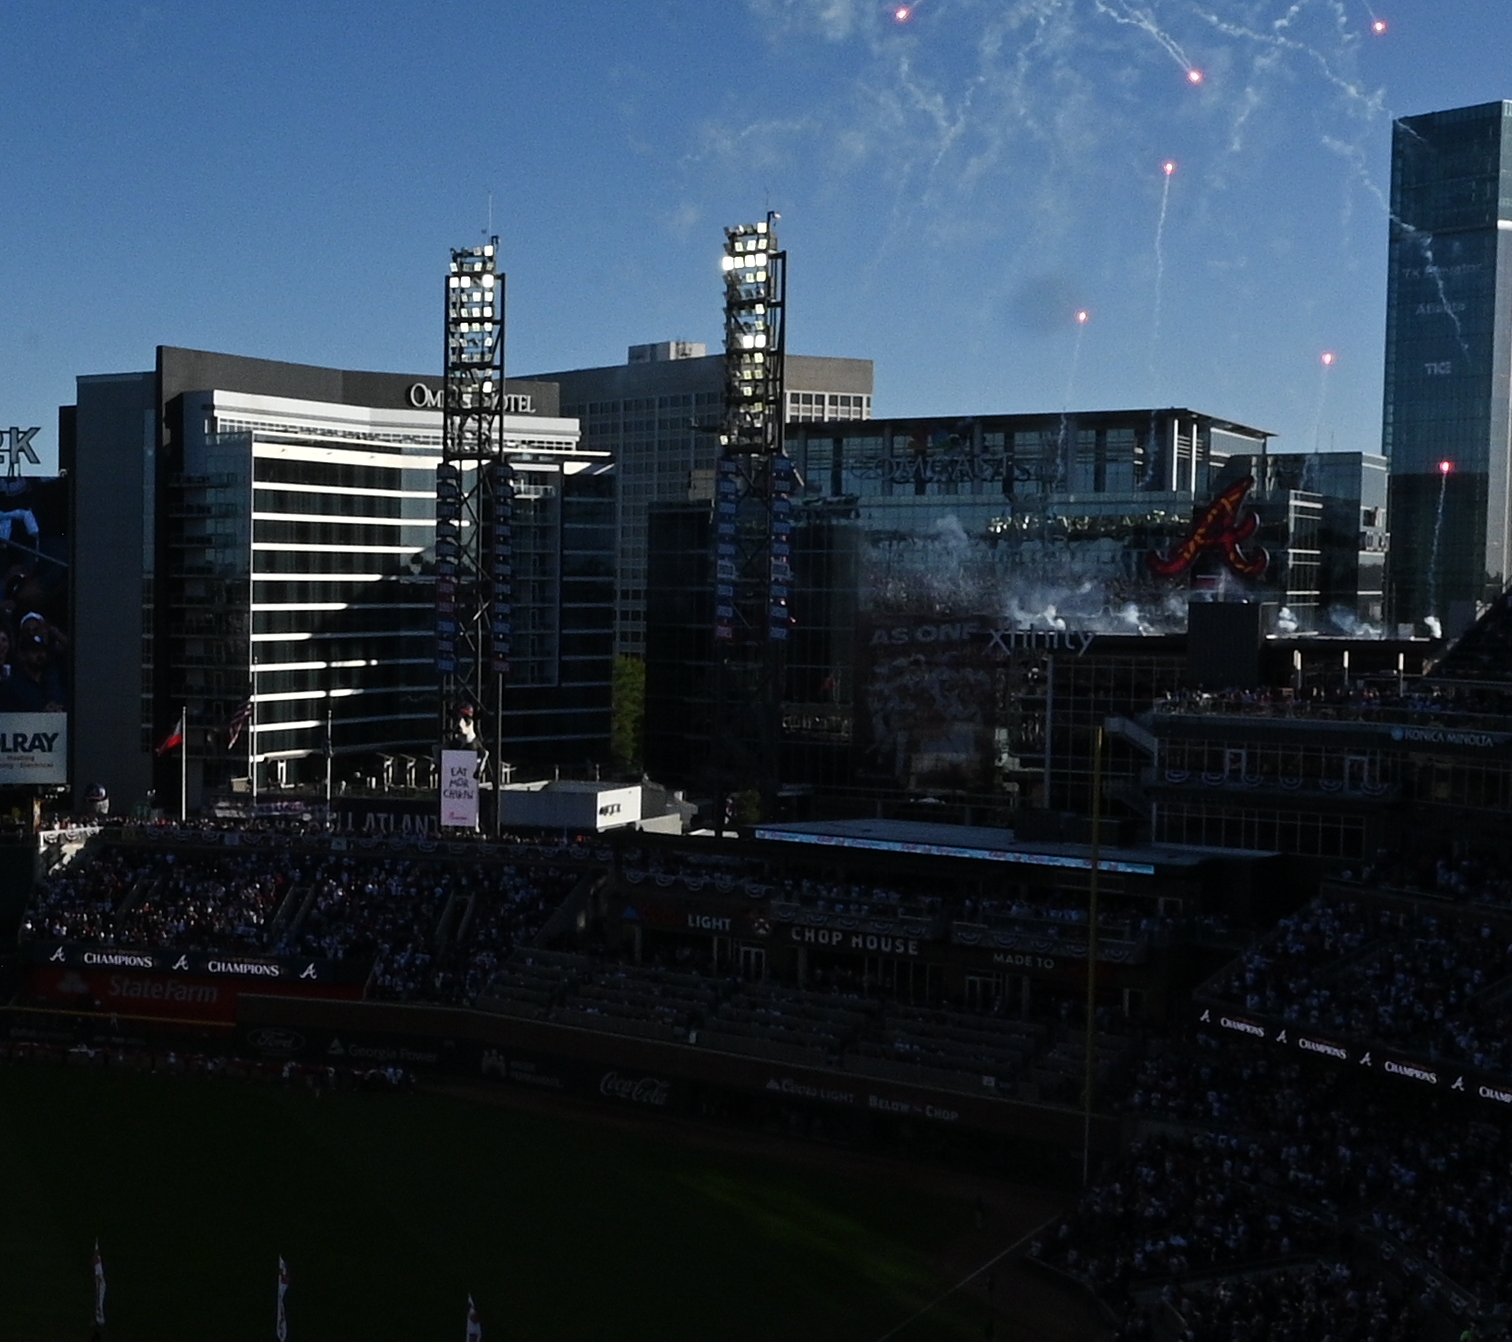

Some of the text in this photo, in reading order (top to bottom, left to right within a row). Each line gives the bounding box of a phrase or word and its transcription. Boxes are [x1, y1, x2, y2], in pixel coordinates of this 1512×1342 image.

[870, 627, 909, 644] AS
[988, 622, 1094, 657] xfinity
[451, 767, 467, 777] EAT
[363, 812, 439, 833] ATLANT
[687, 913, 732, 932] LIGHT
[790, 925, 920, 956] CHOP HOUSE
[83, 952, 154, 969] CHAMPIONS
[207, 959, 280, 977] CHAMPIONS
[993, 953, 1032, 968] MADE
[1036, 957, 1056, 970] TO
[109, 974, 218, 1003] StateFarm
[257, 1029, 295, 1049] Ford
[349, 1044, 438, 1063] Georgia Power
[1219, 1016, 1265, 1039] CHAMPIONS
[1298, 1037, 1349, 1061] CHAMPIONS
[1383, 1060, 1439, 1086] CHAMPIONS
